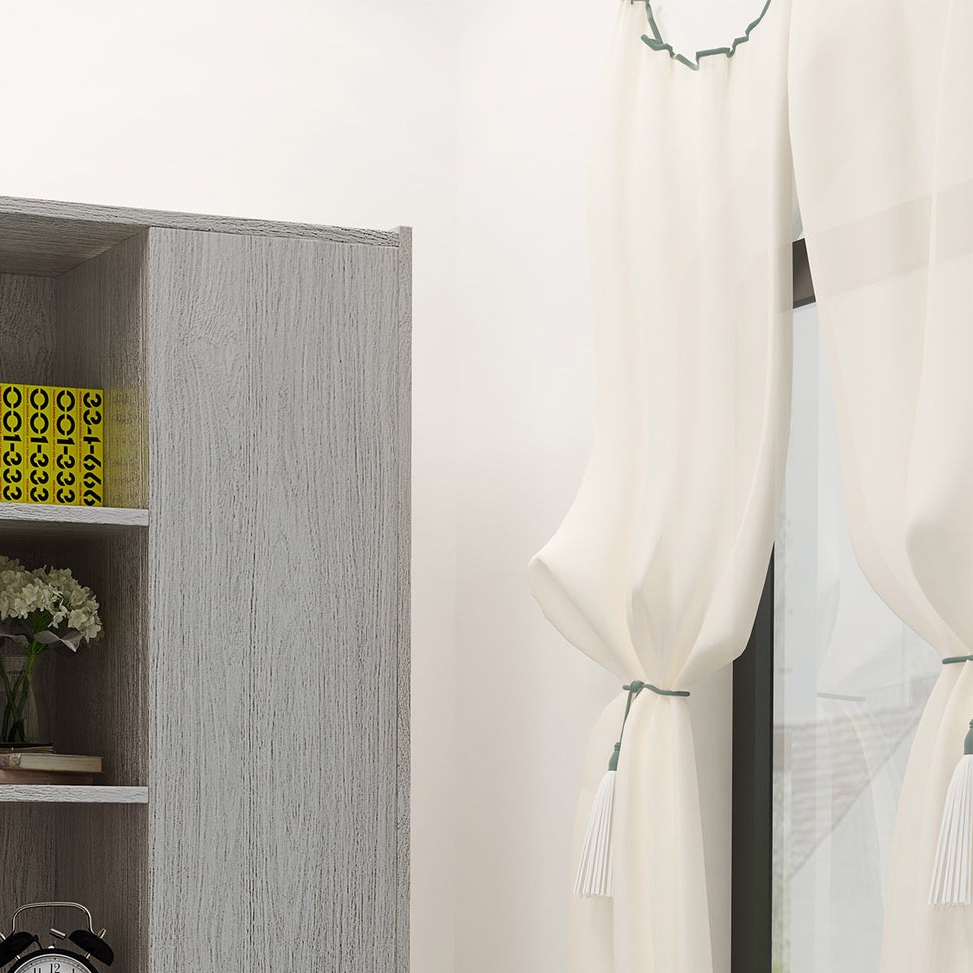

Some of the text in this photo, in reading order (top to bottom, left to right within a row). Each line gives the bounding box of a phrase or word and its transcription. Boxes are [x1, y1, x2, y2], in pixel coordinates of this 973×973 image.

[3, 386, 22, 501] 001-333
[30, 388, 49, 502] 001-333
[56, 390, 75, 504] 001-333
[83, 392, 102, 506] 334-666
[50, 963, 60, 973] 12
